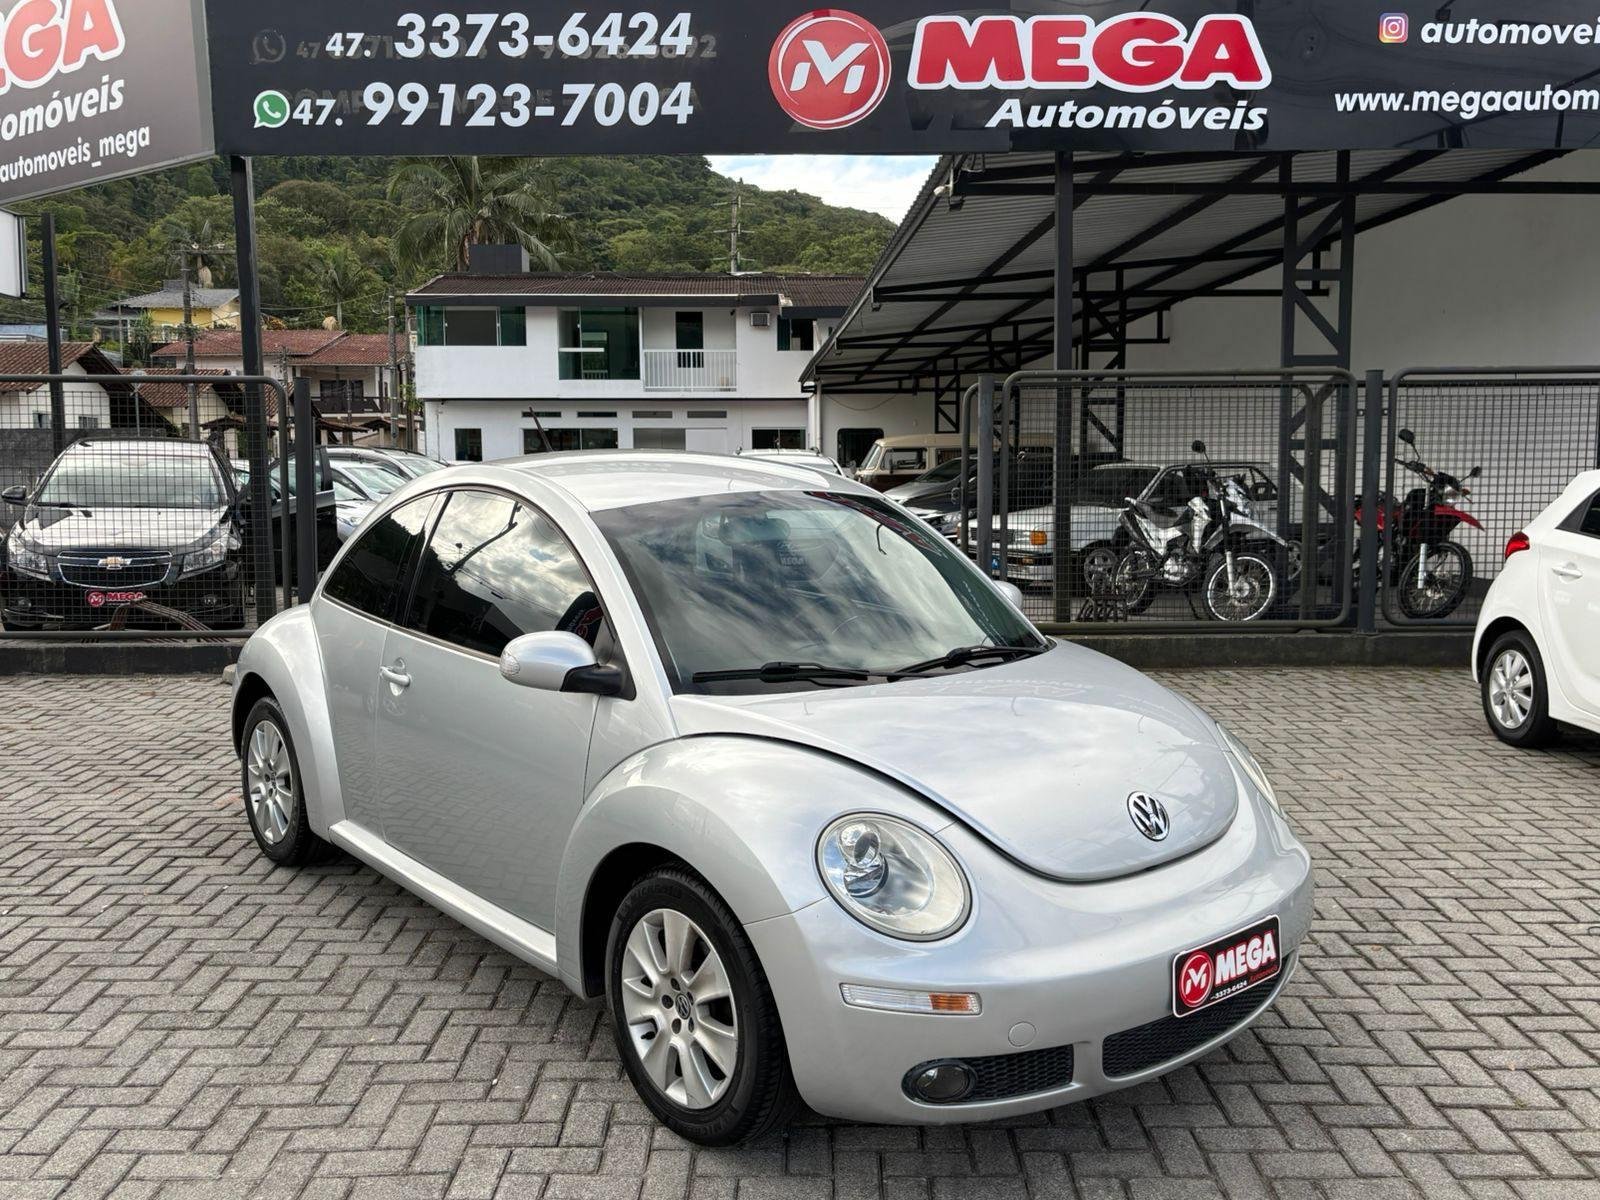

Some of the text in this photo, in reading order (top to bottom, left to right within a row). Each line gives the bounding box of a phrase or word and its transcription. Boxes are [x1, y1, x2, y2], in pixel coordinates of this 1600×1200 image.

[0, 0, 125, 93] GA
[326, 32, 372, 58] 47.
[394, 12, 693, 58] 3373-6424
[907, 12, 1272, 93] MEGA
[0, 74, 124, 140] omóveis
[292, 98, 344, 127] 47.
[363, 82, 694, 127] 99123-7004
[985, 98, 1267, 131] Automóveis
[1334, 84, 1600, 119] www.megaautom
[1215, 931, 1276, 986] MEGA
